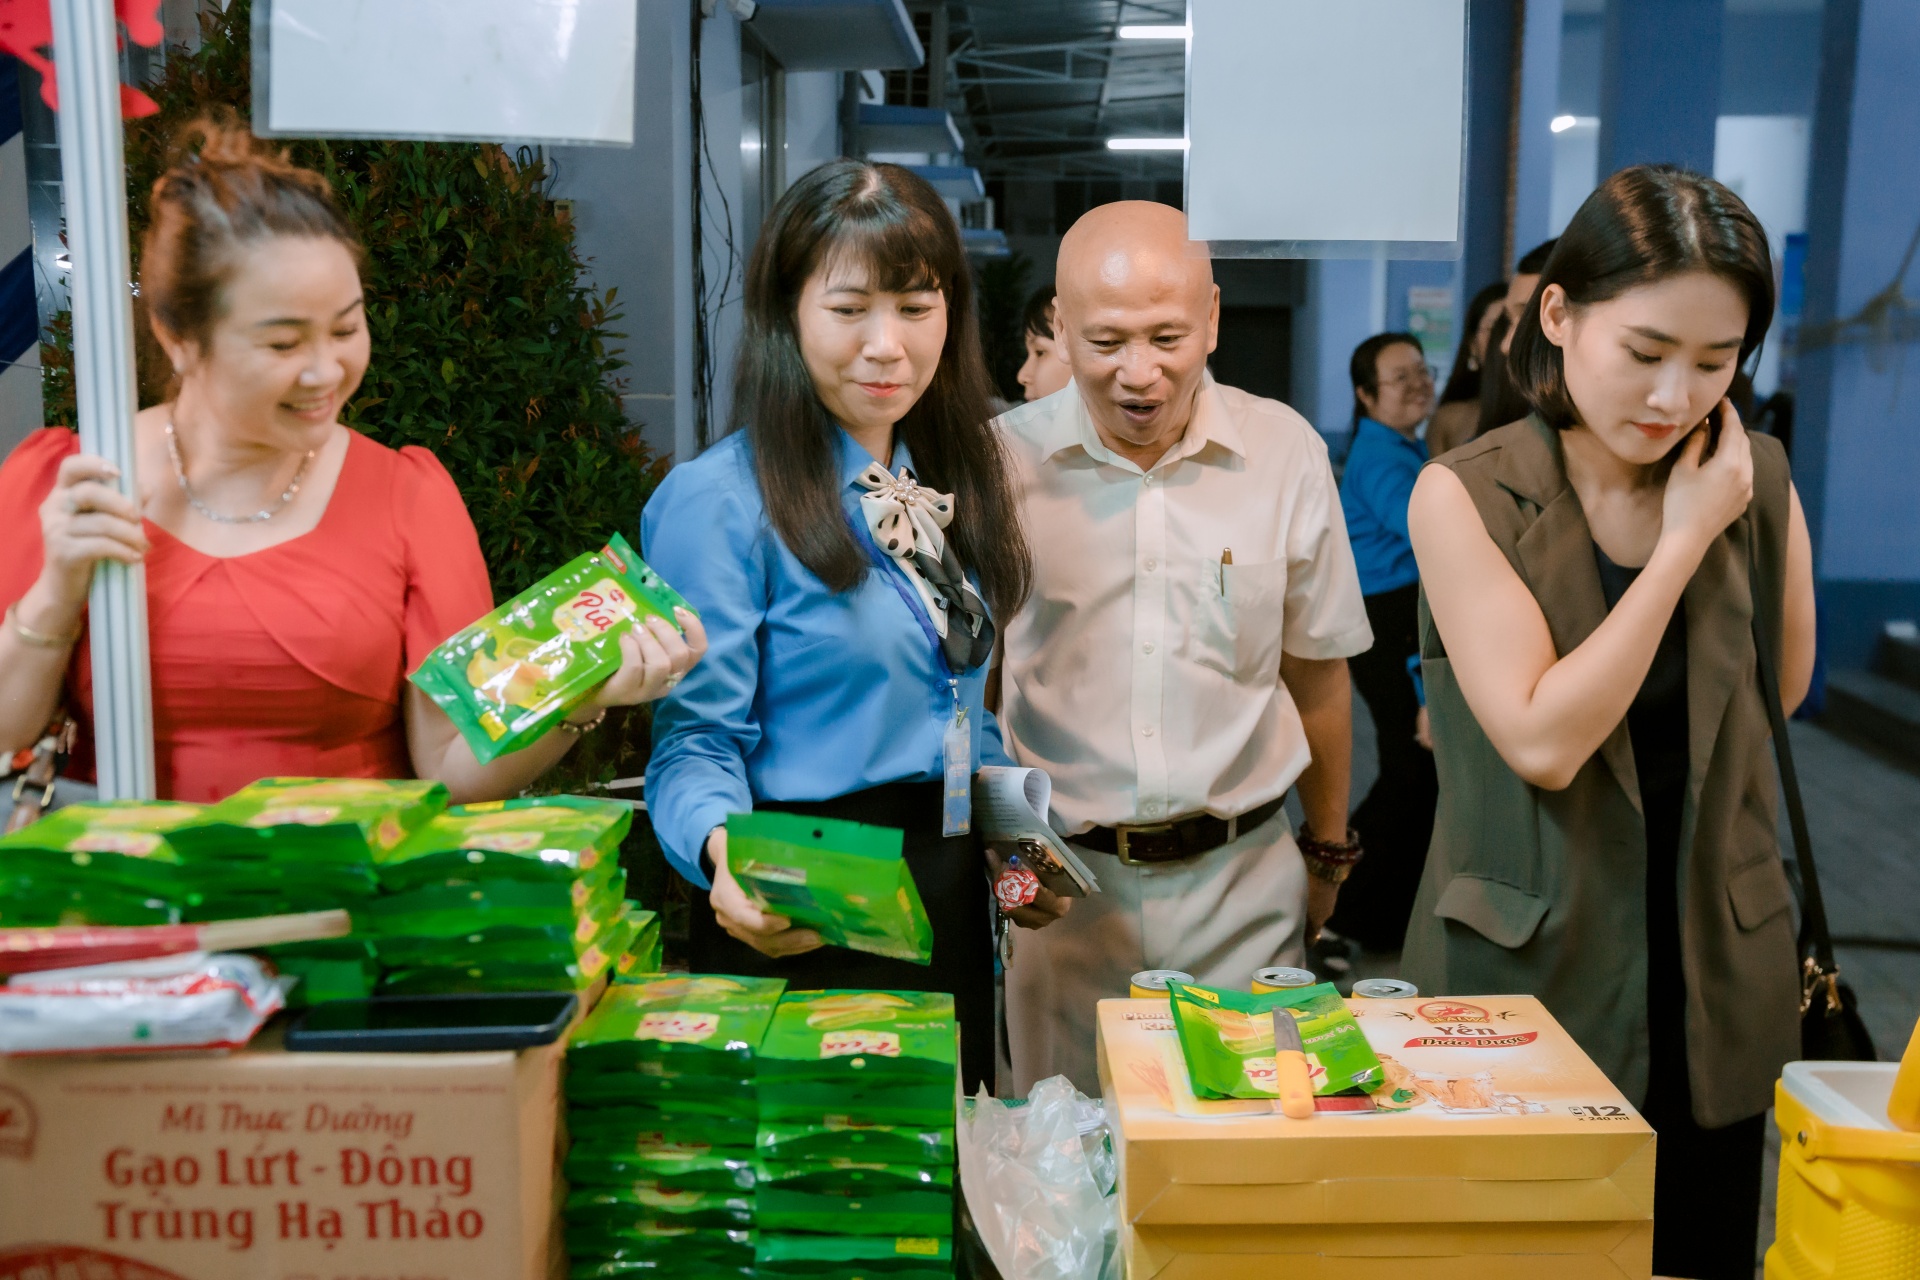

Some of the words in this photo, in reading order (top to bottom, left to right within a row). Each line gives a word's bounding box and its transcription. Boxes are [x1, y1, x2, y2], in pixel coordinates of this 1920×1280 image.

[1433, 1023, 1498, 1036] Yến
[1582, 1106, 1626, 1116] 12
[105, 1147, 201, 1198] Gạo
[216, 1141, 302, 1188] Lứt
[339, 1142, 473, 1198] Đông
[97, 1198, 254, 1252] Trùng
[278, 1200, 344, 1252] Hạ
[356, 1194, 485, 1240] Thảo
